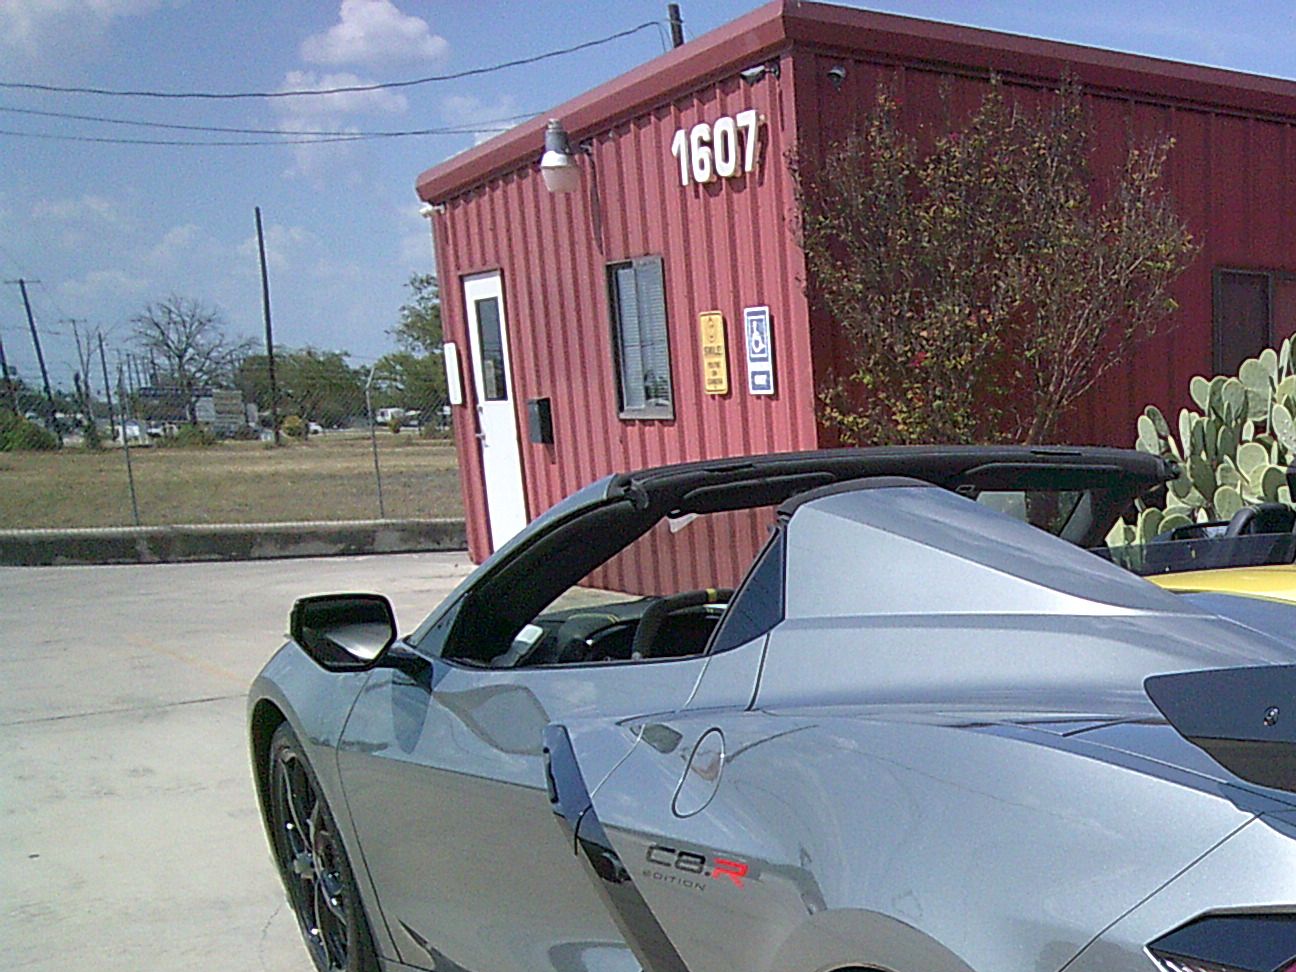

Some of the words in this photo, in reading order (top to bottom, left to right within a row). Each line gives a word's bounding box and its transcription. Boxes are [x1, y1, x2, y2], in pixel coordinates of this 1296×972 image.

[671, 109, 757, 186] 1607
[642, 868, 707, 891] EDITION
[646, 845, 749, 891] C8.R
